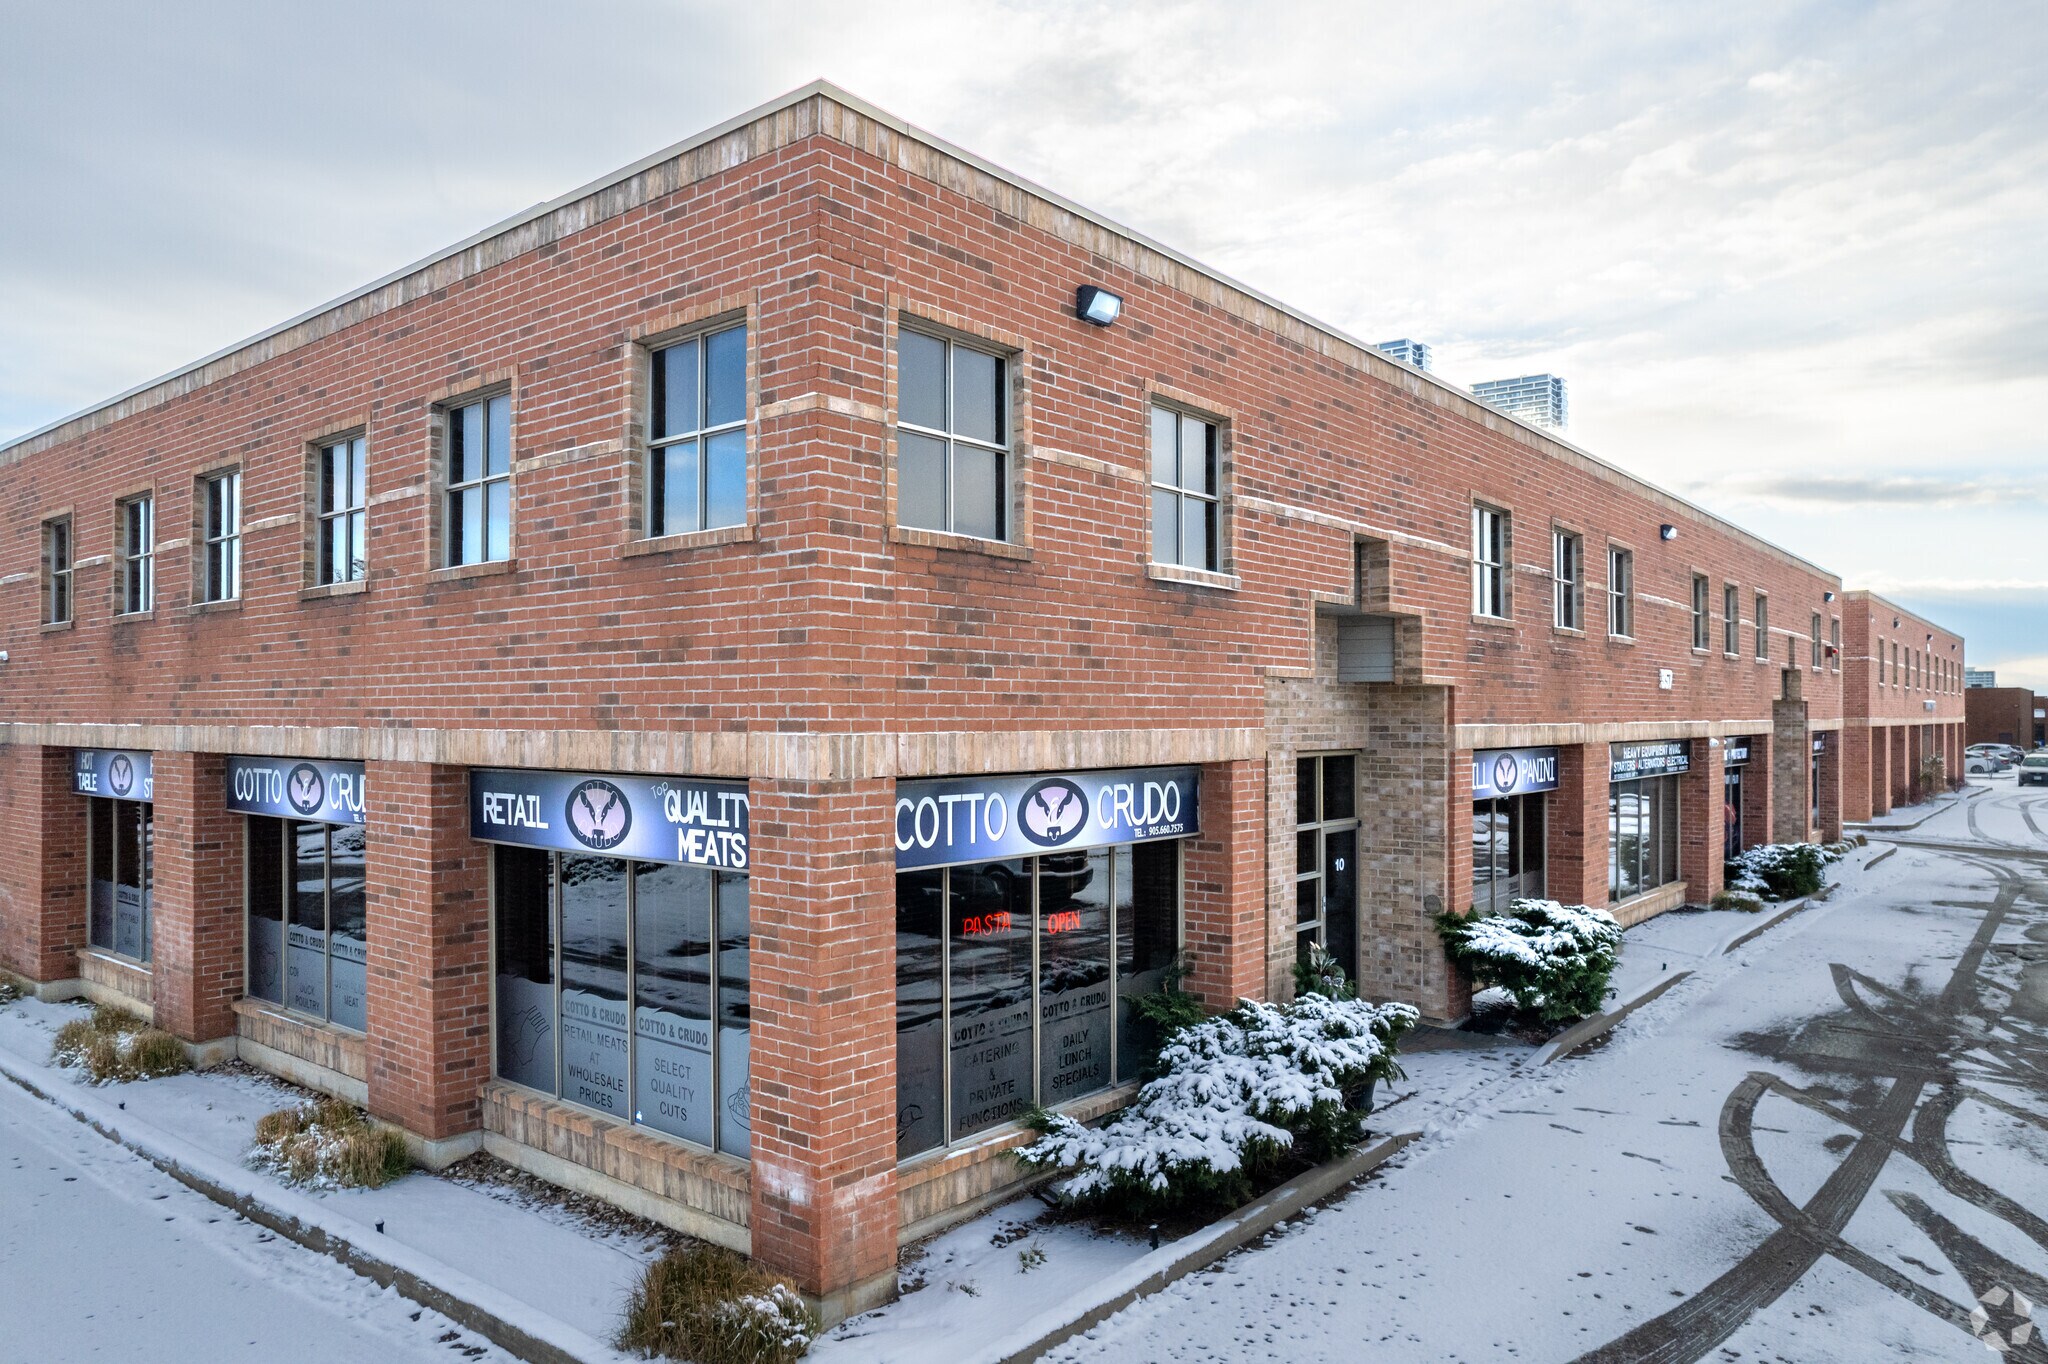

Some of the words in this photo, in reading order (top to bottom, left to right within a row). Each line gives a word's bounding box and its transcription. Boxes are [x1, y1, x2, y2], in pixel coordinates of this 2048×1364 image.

[81, 752, 94, 770] HOT
[1623, 746, 1640, 759] HEAVY
[1641, 745, 1668, 758] EQUIPMENT
[1669, 744, 1681, 755] HVAC
[1521, 757, 1555, 785] PANINI
[1613, 760, 1635, 773] STARTERS
[1638, 757, 1665, 770] ALTERNATORS
[1667, 755, 1689, 767] ELECTRICAL
[78, 772, 97, 791] TABLE
[235, 767, 282, 804] COTTO
[483, 792, 549, 829] RETAIL
[894, 792, 1008, 851] COTTO
[1097, 780, 1180, 830] CRUDO
[1148, 823, 1184, 836] 905.660.7575
[678, 827, 747, 868] MEATS
[1335, 857, 1345, 871] 10
[963, 911, 1011, 938] PASTA
[1047, 910, 1080, 935] OPEN
[289, 931, 304, 944] COTTO
[309, 936, 325, 948] CRUDO
[332, 942, 348, 954] COTTO
[295, 995, 320, 1011] POULTRY
[344, 996, 359, 1008] MEAT
[565, 1000, 589, 1017] COTTO
[591, 1006, 597, 1018] &
[600, 1008, 626, 1025] CRUDO
[1042, 1000, 1069, 1018] COTTO
[1080, 991, 1107, 1007] CRUDO
[564, 1024, 594, 1044] RETAIL
[597, 1032, 628, 1053] MEATS
[638, 1017, 666, 1036] COTTO
[669, 1024, 675, 1038] &
[678, 1026, 708, 1046] CRUDO
[954, 1022, 986, 1042] COTTO
[1063, 1029, 1089, 1048] DAILY
[589, 1051, 600, 1066] AT
[964, 1041, 1020, 1068] CATERING
[1059, 1047, 1092, 1069] LUNCH
[568, 1063, 624, 1093] WHOLESALE
[654, 1057, 691, 1080] SELECT
[989, 1067, 996, 1081] &
[1052, 1063, 1100, 1089] SPECIALS
[580, 1086, 613, 1108] PRICES
[650, 1078, 695, 1103] QUALITY
[969, 1079, 1015, 1105] PRIVATE
[660, 1101, 687, 1121] CUTS
[959, 1097, 1023, 1131] FUNCTIONS
